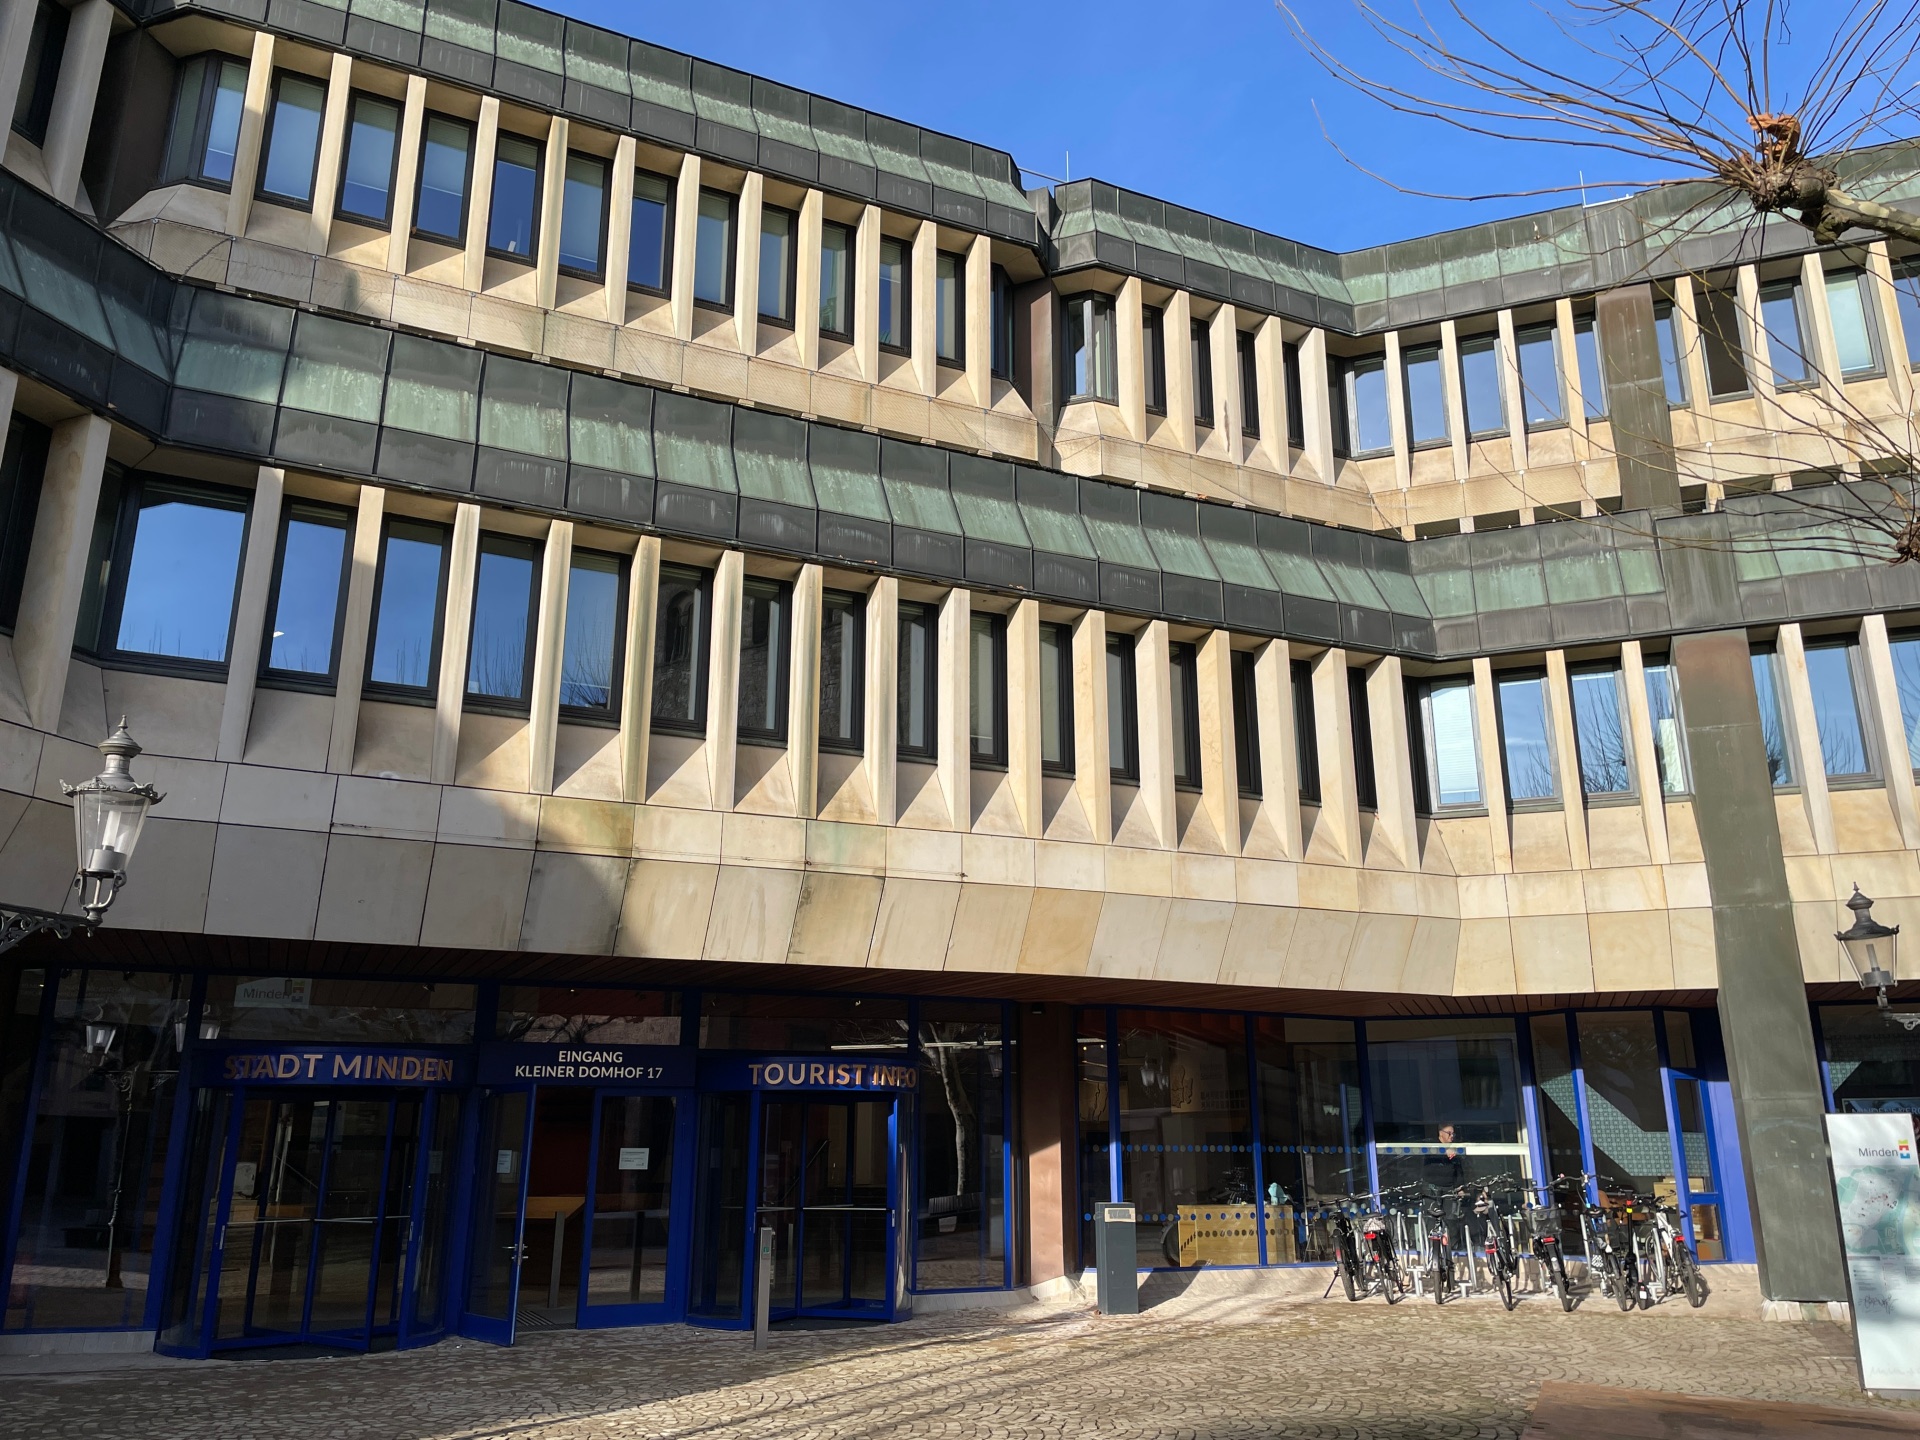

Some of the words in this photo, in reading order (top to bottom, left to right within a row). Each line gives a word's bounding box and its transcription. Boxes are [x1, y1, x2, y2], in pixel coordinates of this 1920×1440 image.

[558, 1050, 623, 1063] EINGANG
[223, 1054, 323, 1080] STADT
[332, 1055, 454, 1082] MINDEN
[515, 1065, 575, 1078] KLEINER
[578, 1066, 644, 1078] DOMHOF
[647, 1067, 663, 1079] 17
[748, 1063, 867, 1086] TOURIST
[872, 1064, 917, 1088] INFO
[1858, 1147, 1899, 1157] Minden
